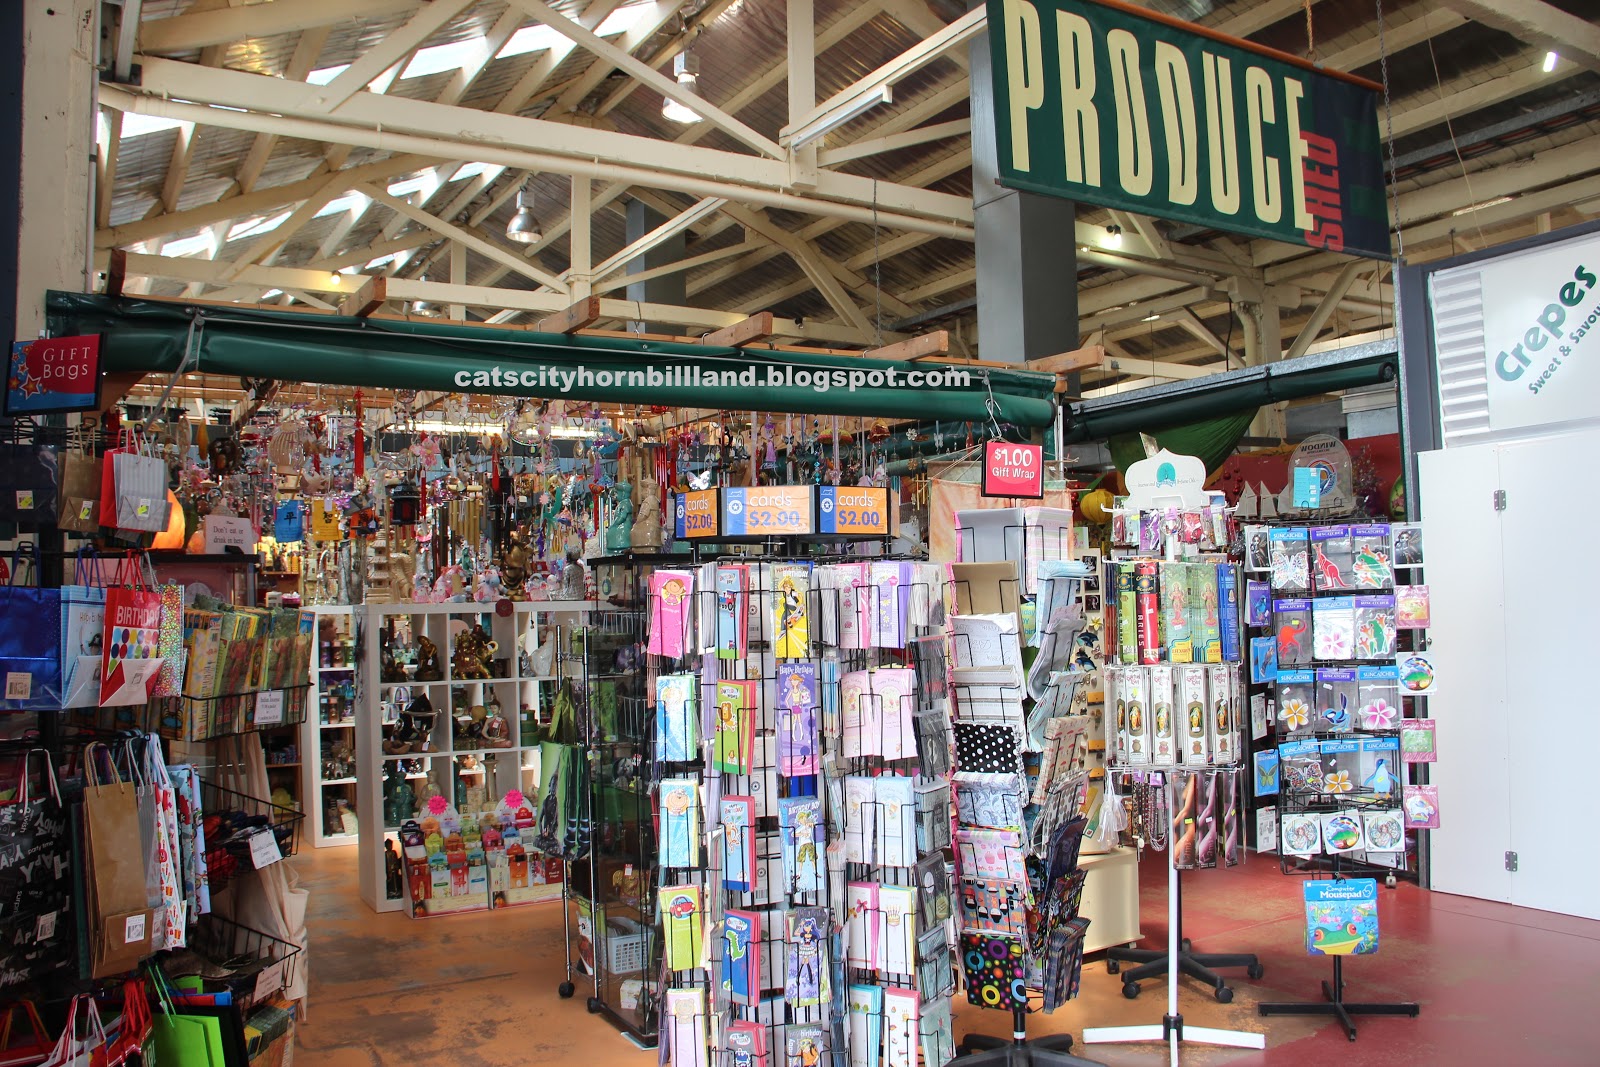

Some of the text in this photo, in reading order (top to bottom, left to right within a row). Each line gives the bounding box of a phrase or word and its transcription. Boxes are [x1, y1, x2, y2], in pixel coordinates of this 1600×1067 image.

[1003, 0, 1314, 231] PRODUCE
[1304, 130, 1344, 252] SHED
[1495, 265, 1597, 382] Crepes
[43, 347, 91, 362] GIFT
[43, 364, 88, 380] Bags
[1528, 357, 1562, 394] Sweet
[1559, 345, 1572, 357] &
[994, 448, 1033, 467] $1.00
[992, 467, 1035, 481] Gift Wrap
[687, 494, 709, 511] cards
[749, 490, 792, 507] cards
[838, 490, 873, 507] cards
[686, 513, 712, 530] $2.00
[749, 510, 800, 527] $2.00
[838, 510, 880, 527] $2.00
[116, 605, 160, 627] BIRTHDAY
[1137, 614, 1145, 647] ARIES
[780, 665, 813, 675] Happy Birthday
[1319, 890, 1362, 900] Mousepad
[1326, 885, 1356, 893] Computer
[800, 1028, 823, 1038] birthday
